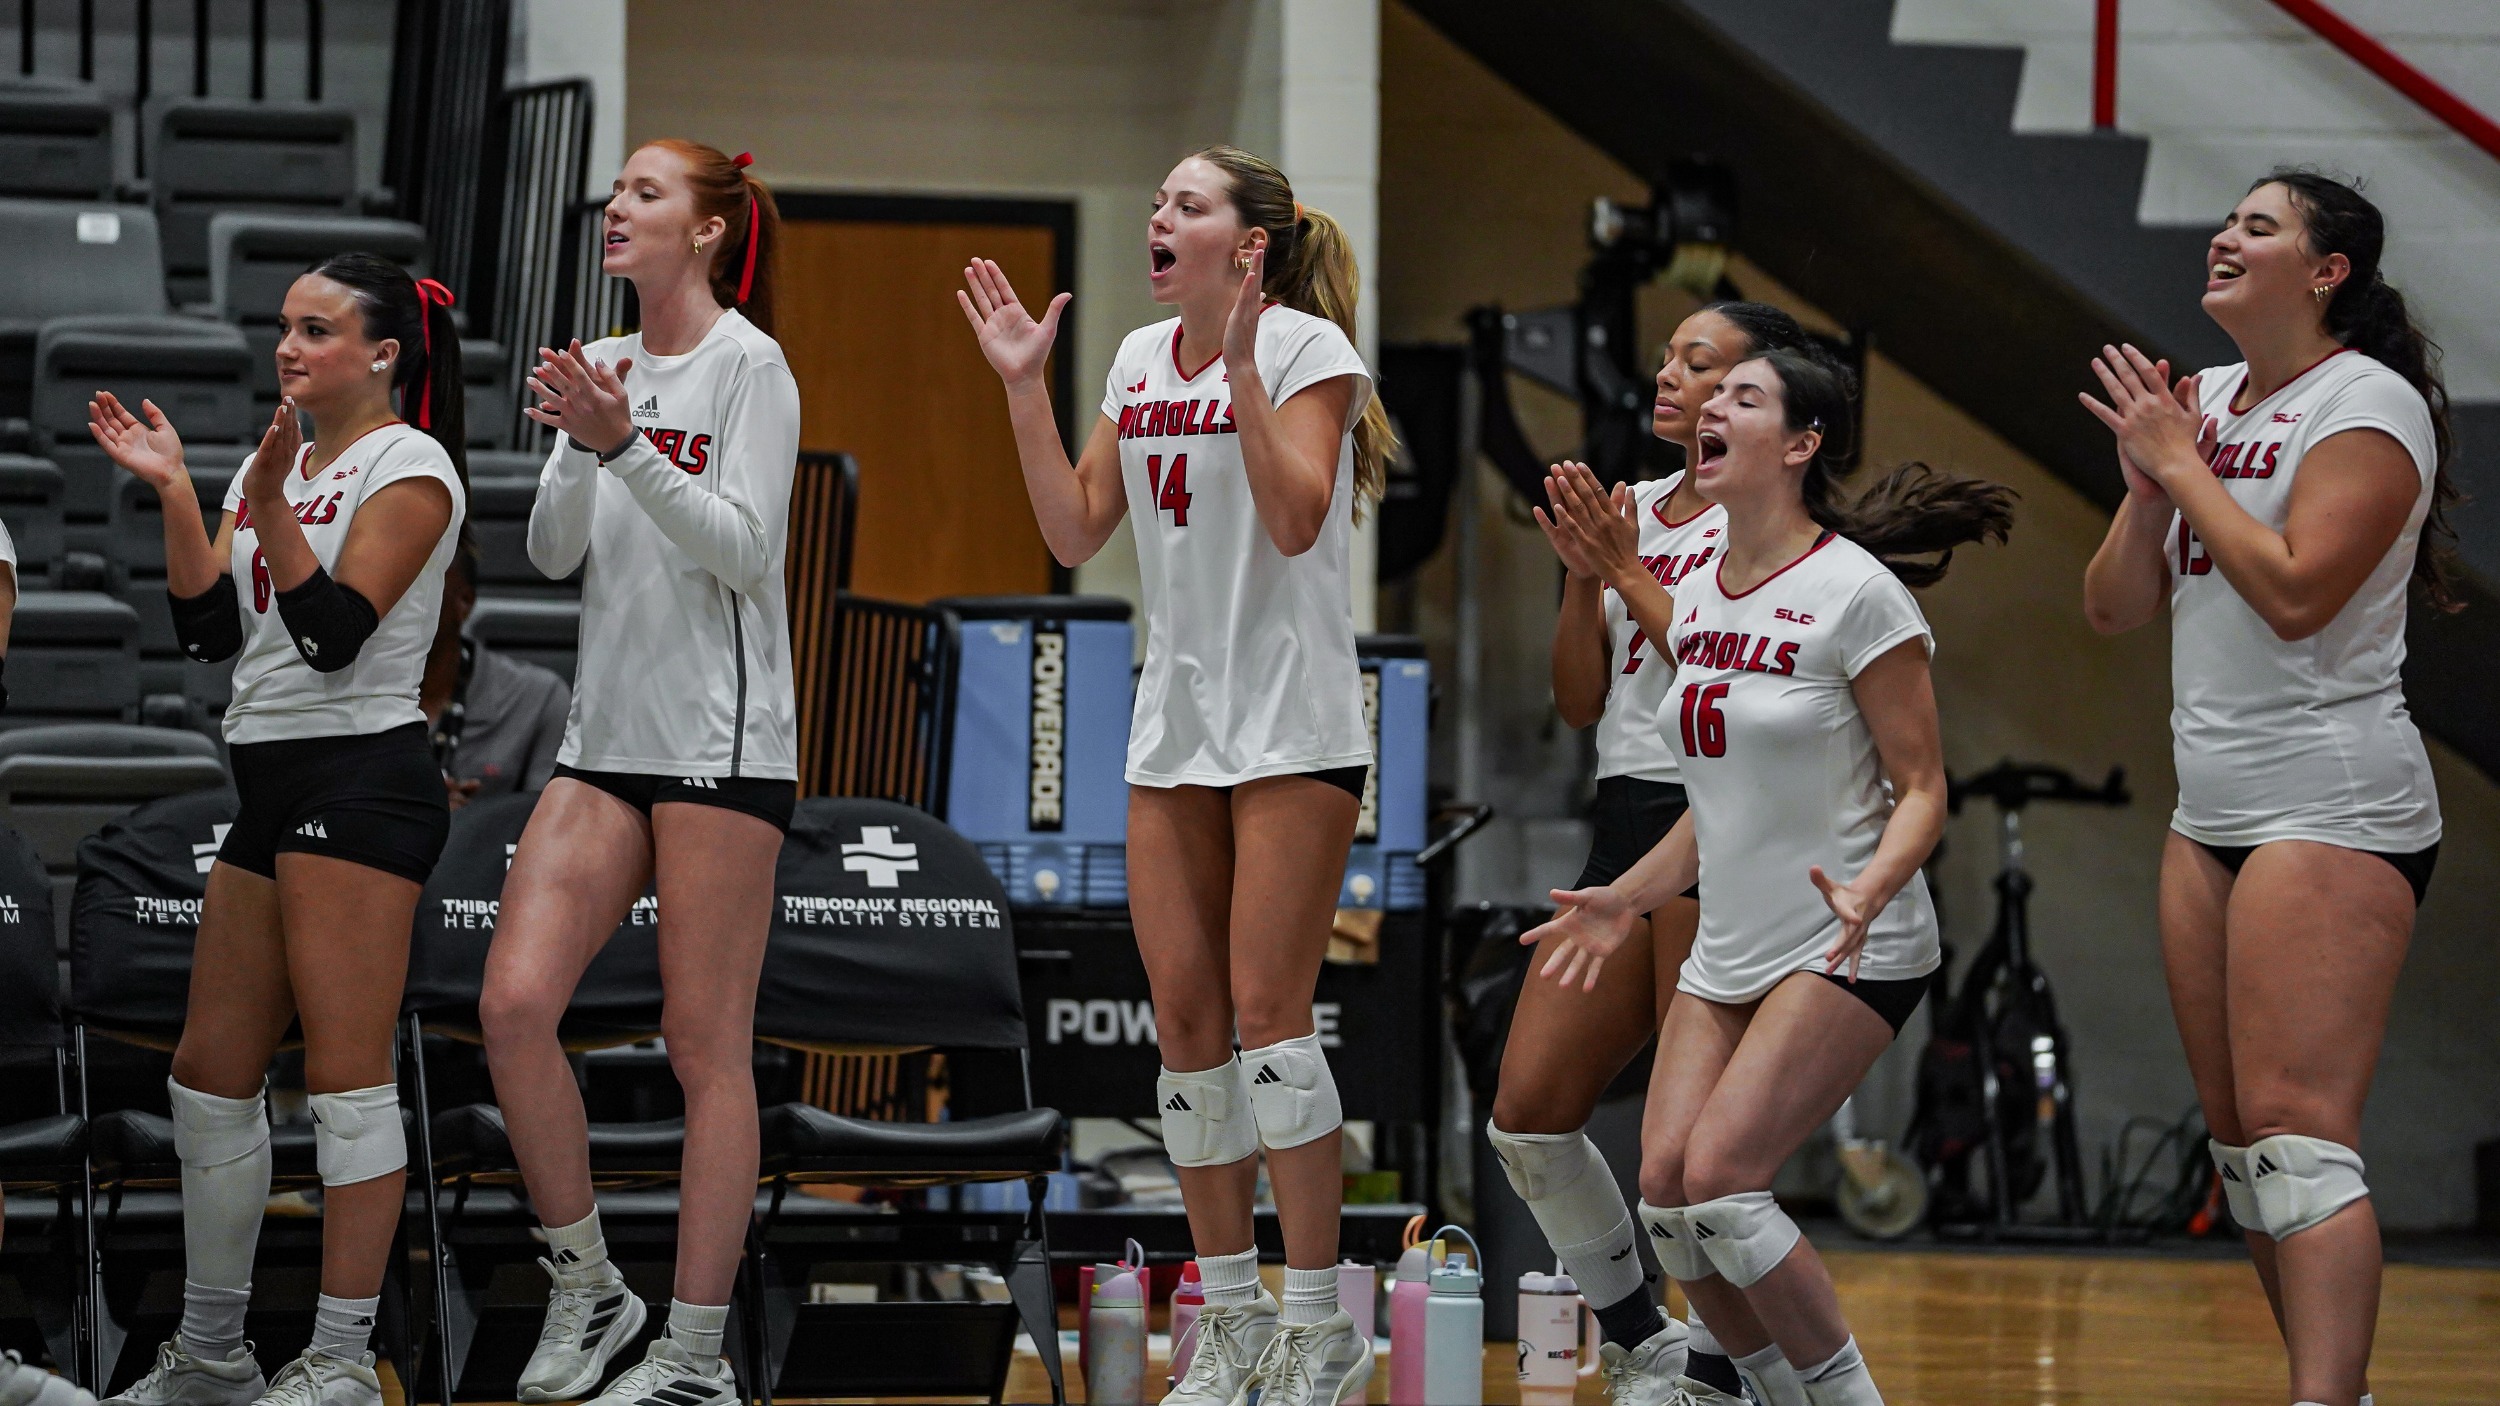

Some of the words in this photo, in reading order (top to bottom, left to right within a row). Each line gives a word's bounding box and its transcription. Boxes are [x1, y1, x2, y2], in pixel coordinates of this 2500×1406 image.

[632, 408, 660, 418] adidas
[1147, 453, 1193, 527] 14
[252, 545, 270, 614] 6
[1774, 608, 1816, 625] SLC
[1031, 633, 1064, 823] POWERADE
[1680, 682, 1731, 758] 16
[135, 896, 204, 913] THIBO
[442, 899, 500, 915] THIBO
[782, 895, 897, 912] THIBODAUX
[901, 898, 999, 914] REGIONAL
[444, 914, 494, 929] HEA
[785, 909, 884, 926] HEALTH
[899, 912, 1001, 929] SYSTEM
